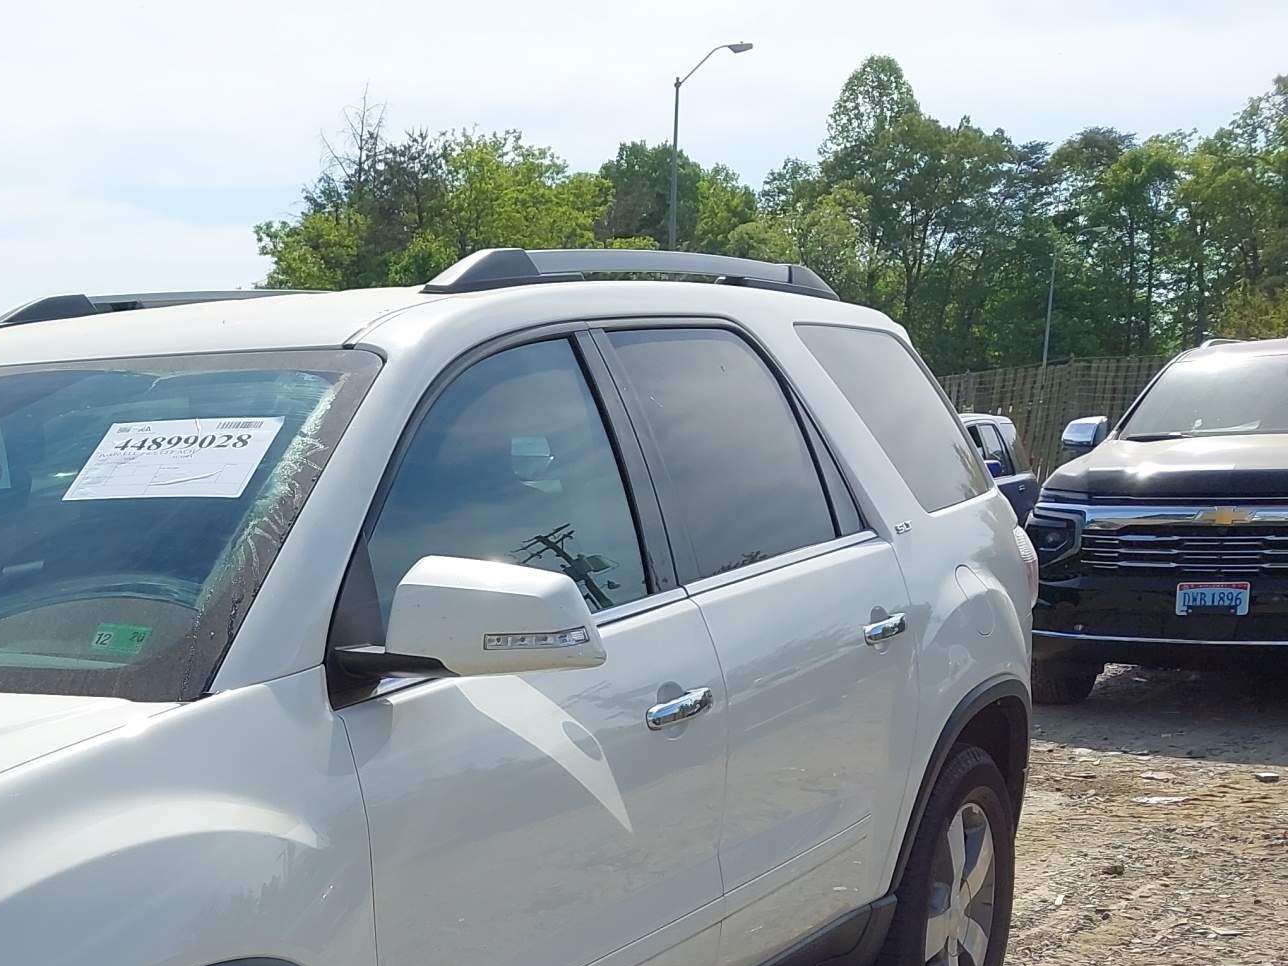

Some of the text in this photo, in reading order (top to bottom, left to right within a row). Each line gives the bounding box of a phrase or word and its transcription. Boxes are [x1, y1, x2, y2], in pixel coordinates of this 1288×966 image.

[114, 433, 252, 451] 44899028
[1212, 592, 1242, 607] 1896
[95, 632, 112, 646] 12
